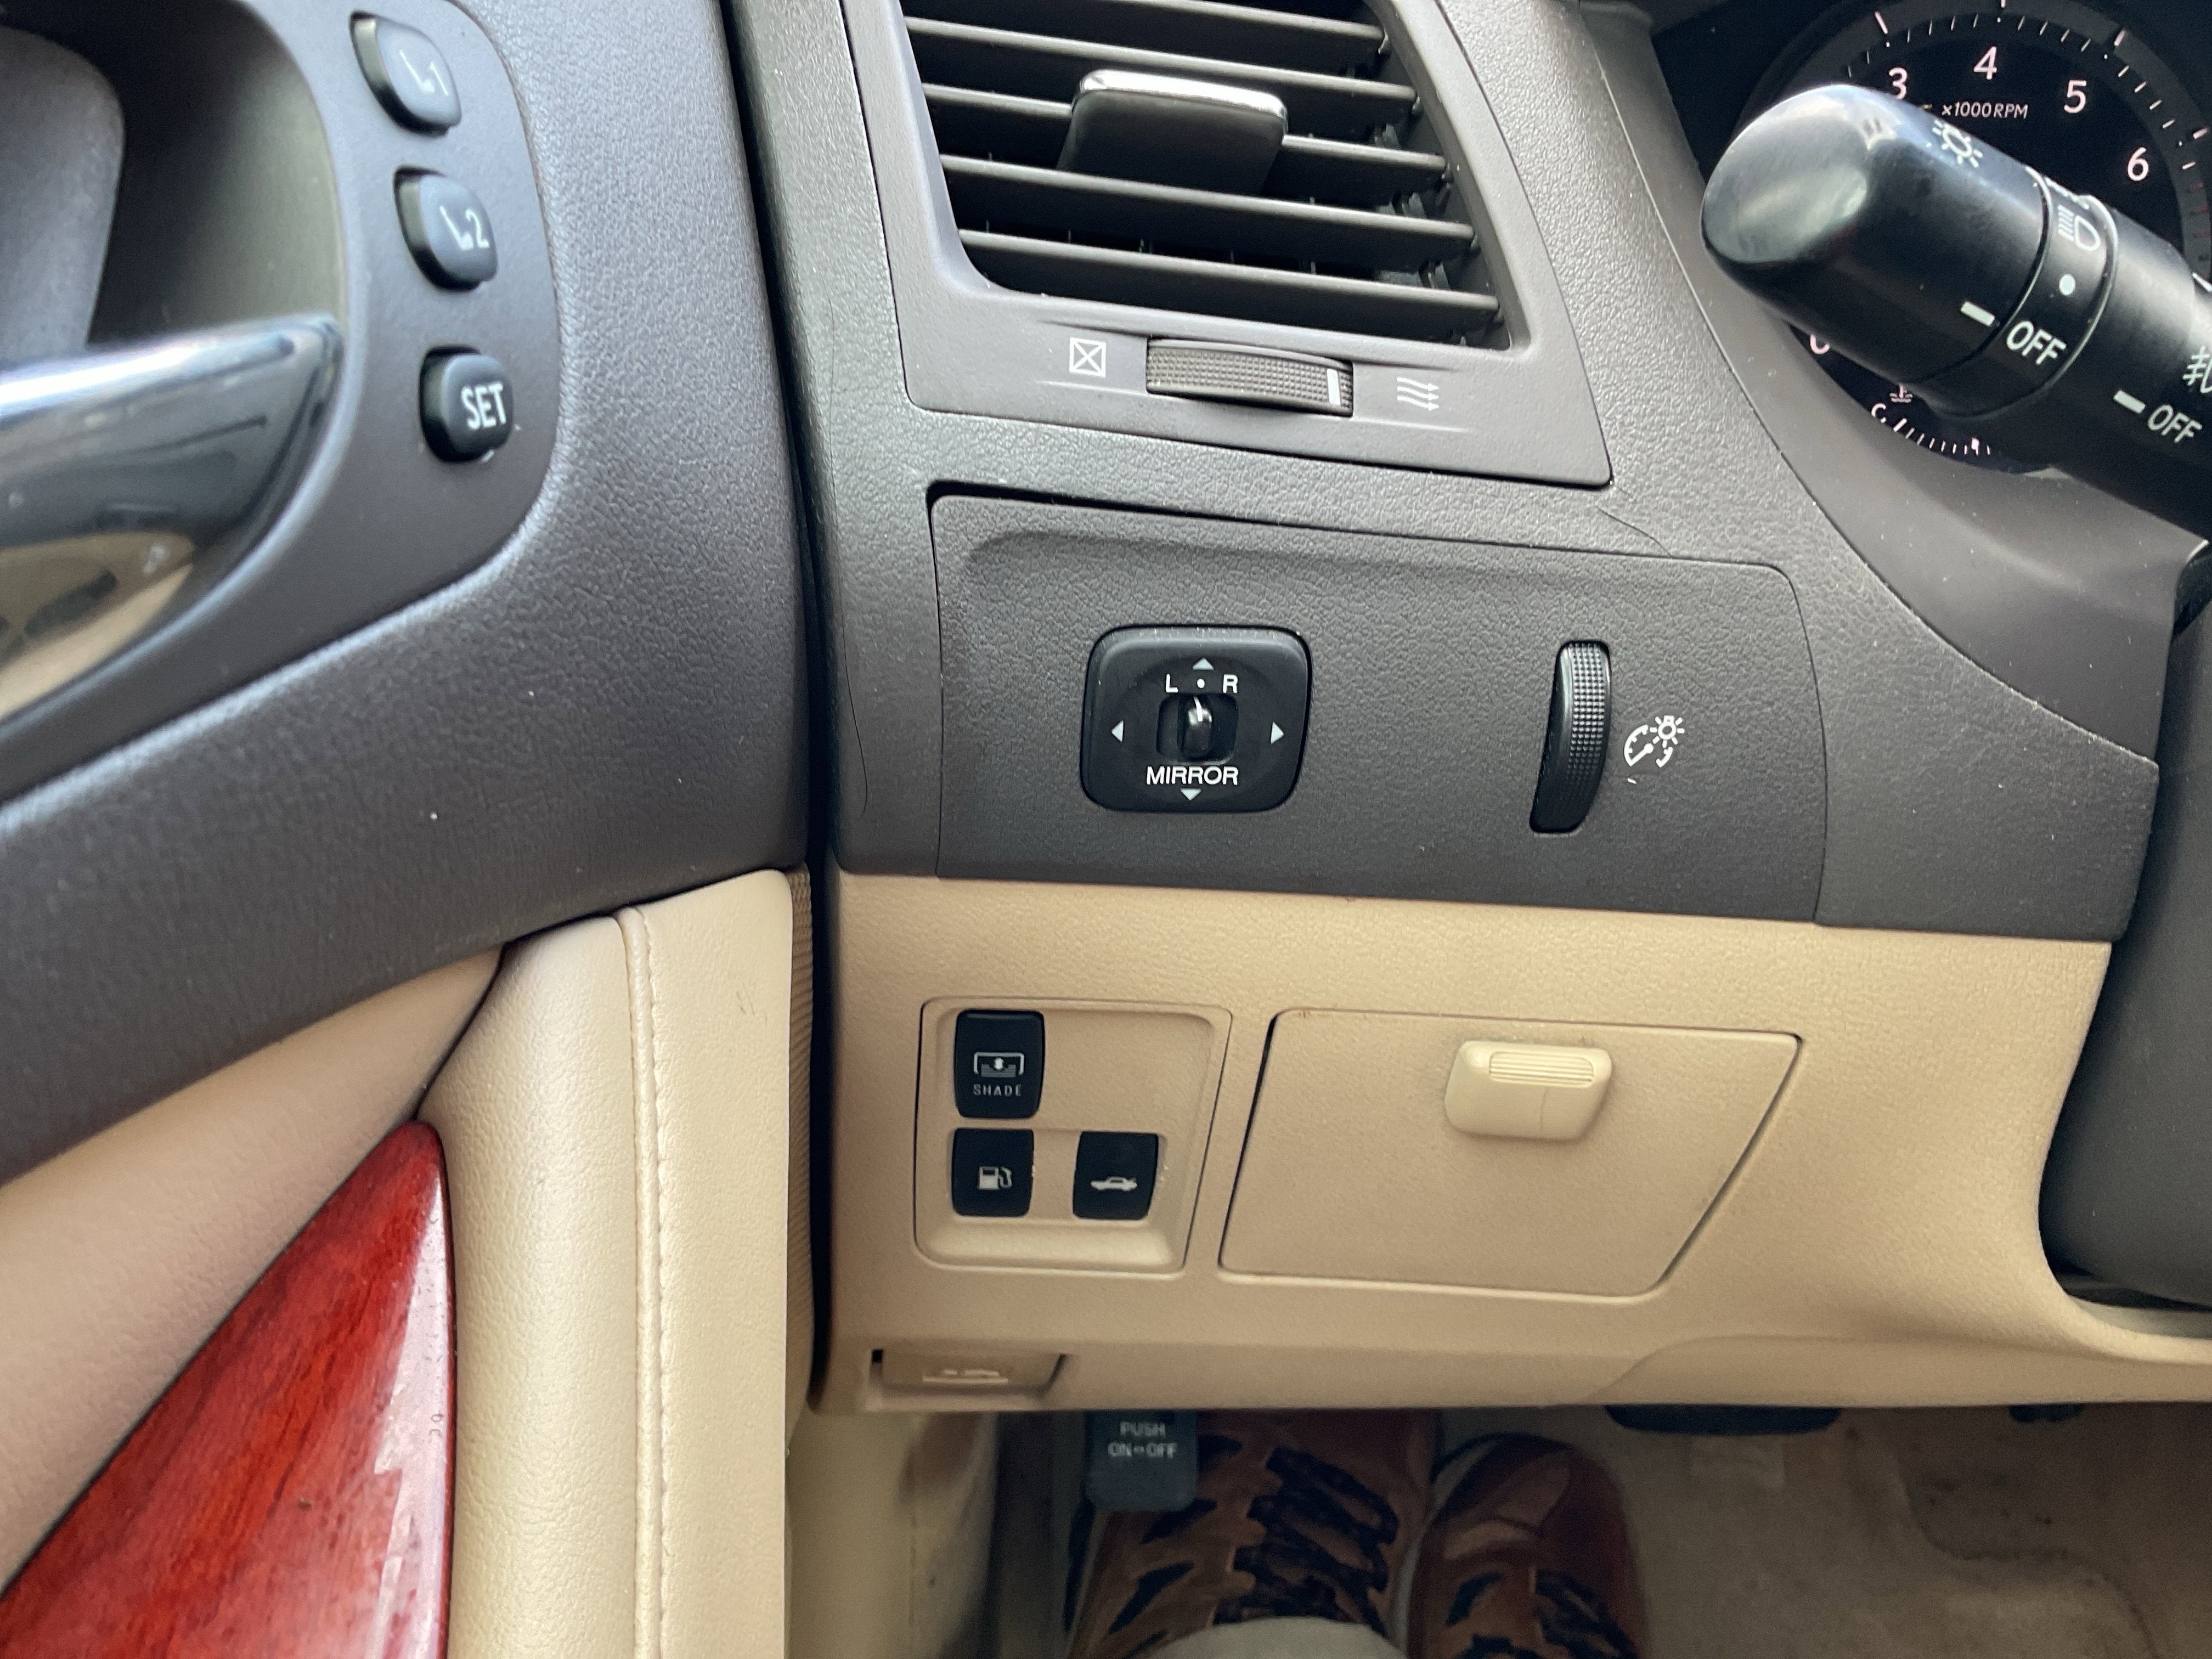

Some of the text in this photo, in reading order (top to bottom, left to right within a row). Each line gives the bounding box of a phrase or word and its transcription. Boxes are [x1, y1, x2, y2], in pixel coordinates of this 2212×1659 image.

[1973, 46, 1997, 80] 4
[1889, 67, 1908, 100] 3
[2064, 80, 2087, 114] 5
[2128, 146, 2149, 181] 6
[465, 208, 489, 249] 2
[2006, 320, 2067, 365] OFF
[461, 381, 506, 430] SET
[2147, 404, 2202, 443] OFF
[1165, 673, 1238, 693] L R
[1146, 766, 1239, 786] MIRROR
[973, 1084, 1022, 1096] SHADE
[1120, 1421, 1166, 1438] PUSH
